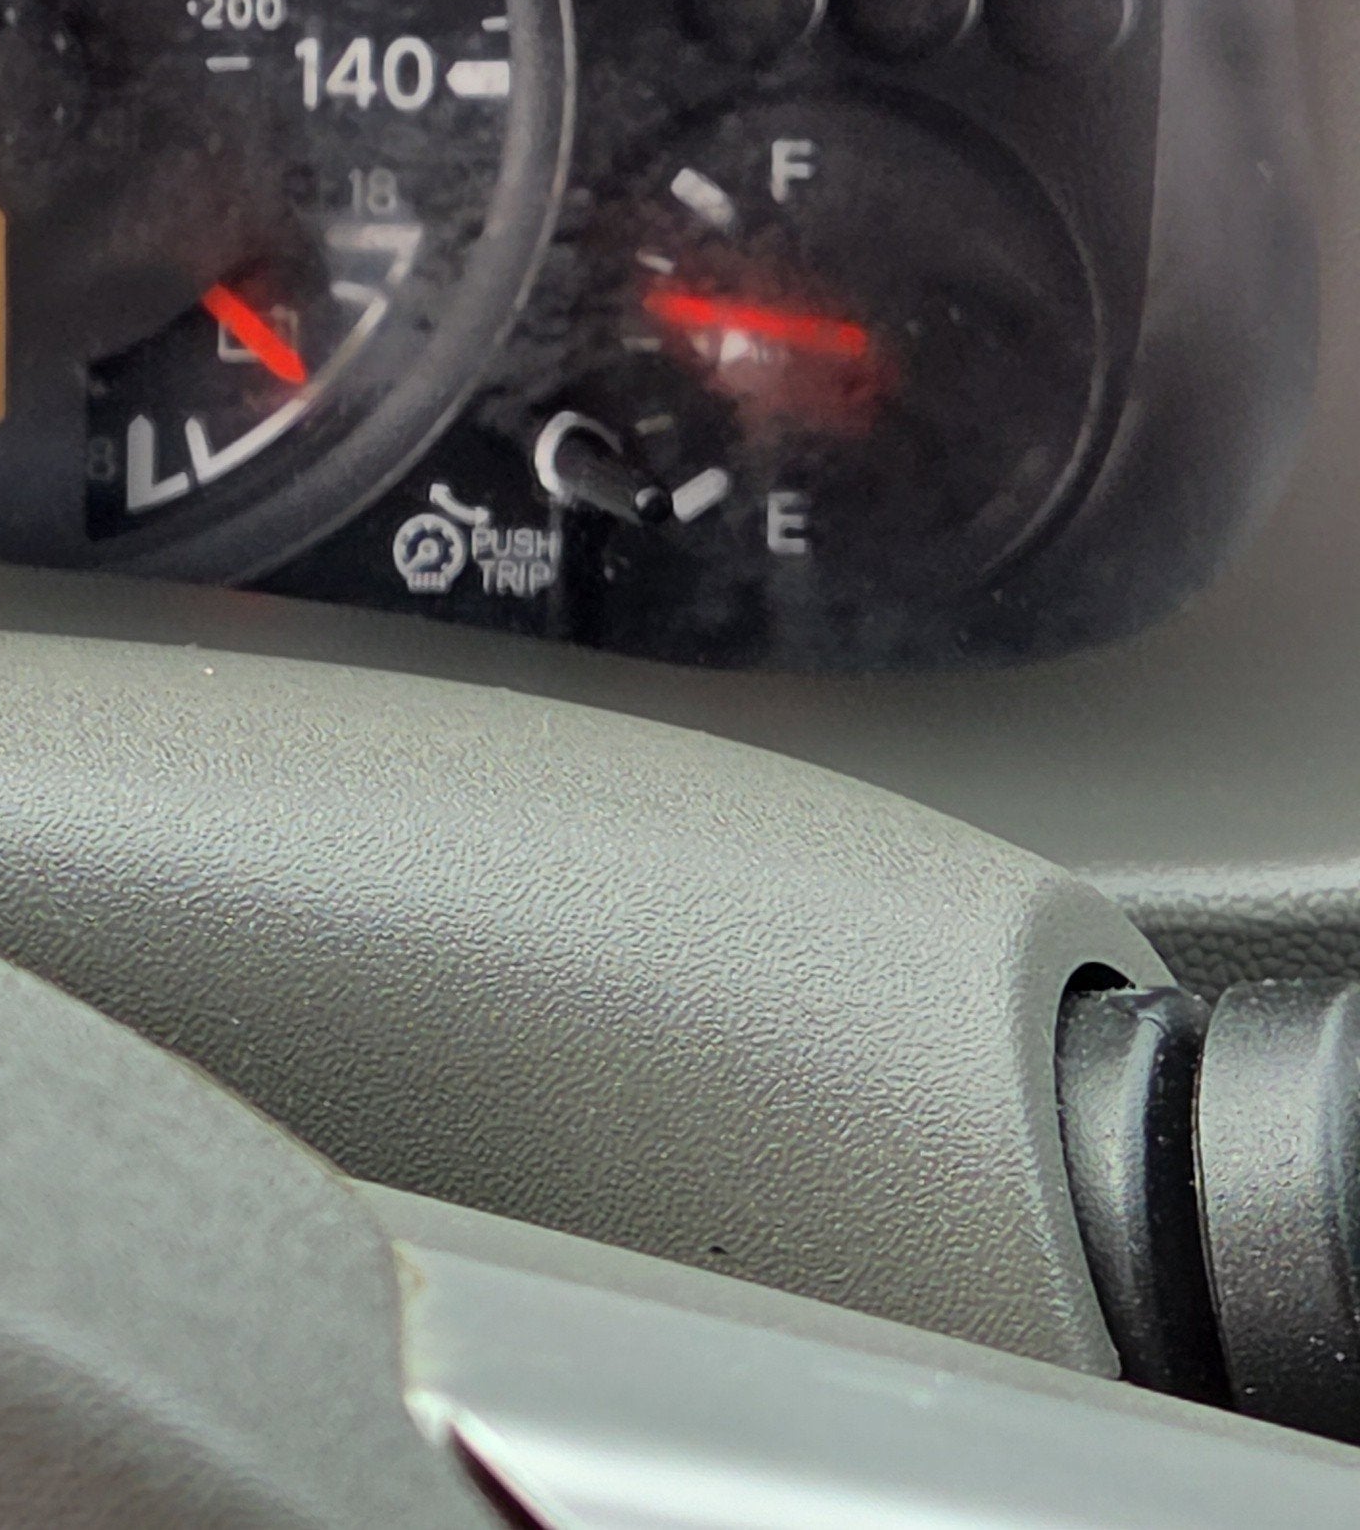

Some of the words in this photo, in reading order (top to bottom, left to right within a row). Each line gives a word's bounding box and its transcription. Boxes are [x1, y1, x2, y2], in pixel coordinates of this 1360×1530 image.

[294, 36, 435, 112] 140
[348, 168, 398, 215] 18
[770, 138, 813, 202] F
[471, 526, 561, 562] PUSH
[766, 491, 808, 554] E
[479, 559, 556, 596] TRIP
